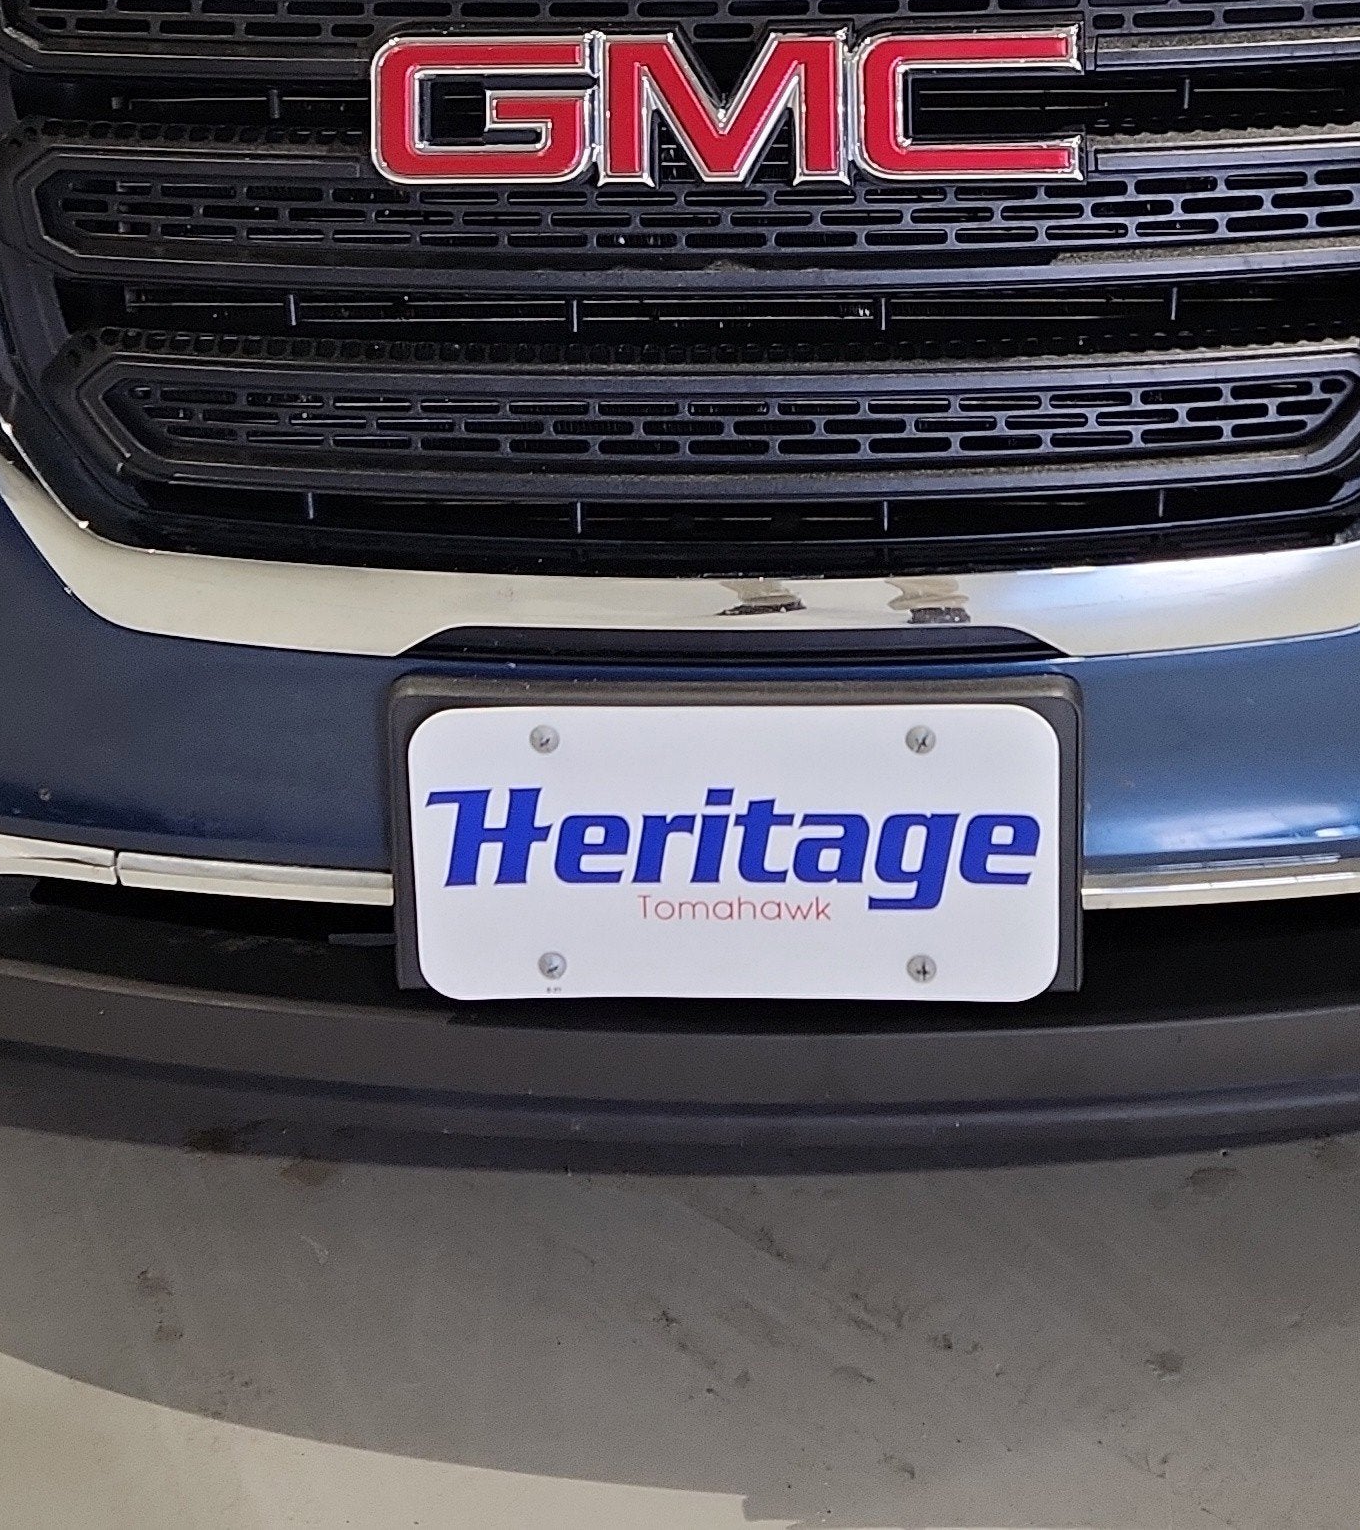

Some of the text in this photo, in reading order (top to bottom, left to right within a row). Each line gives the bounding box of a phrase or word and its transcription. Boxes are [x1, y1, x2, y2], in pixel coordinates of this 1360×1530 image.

[371, 27, 1084, 186] GMC
[425, 787, 1041, 911] Heritage
[637, 895, 832, 922] Tomahawk
